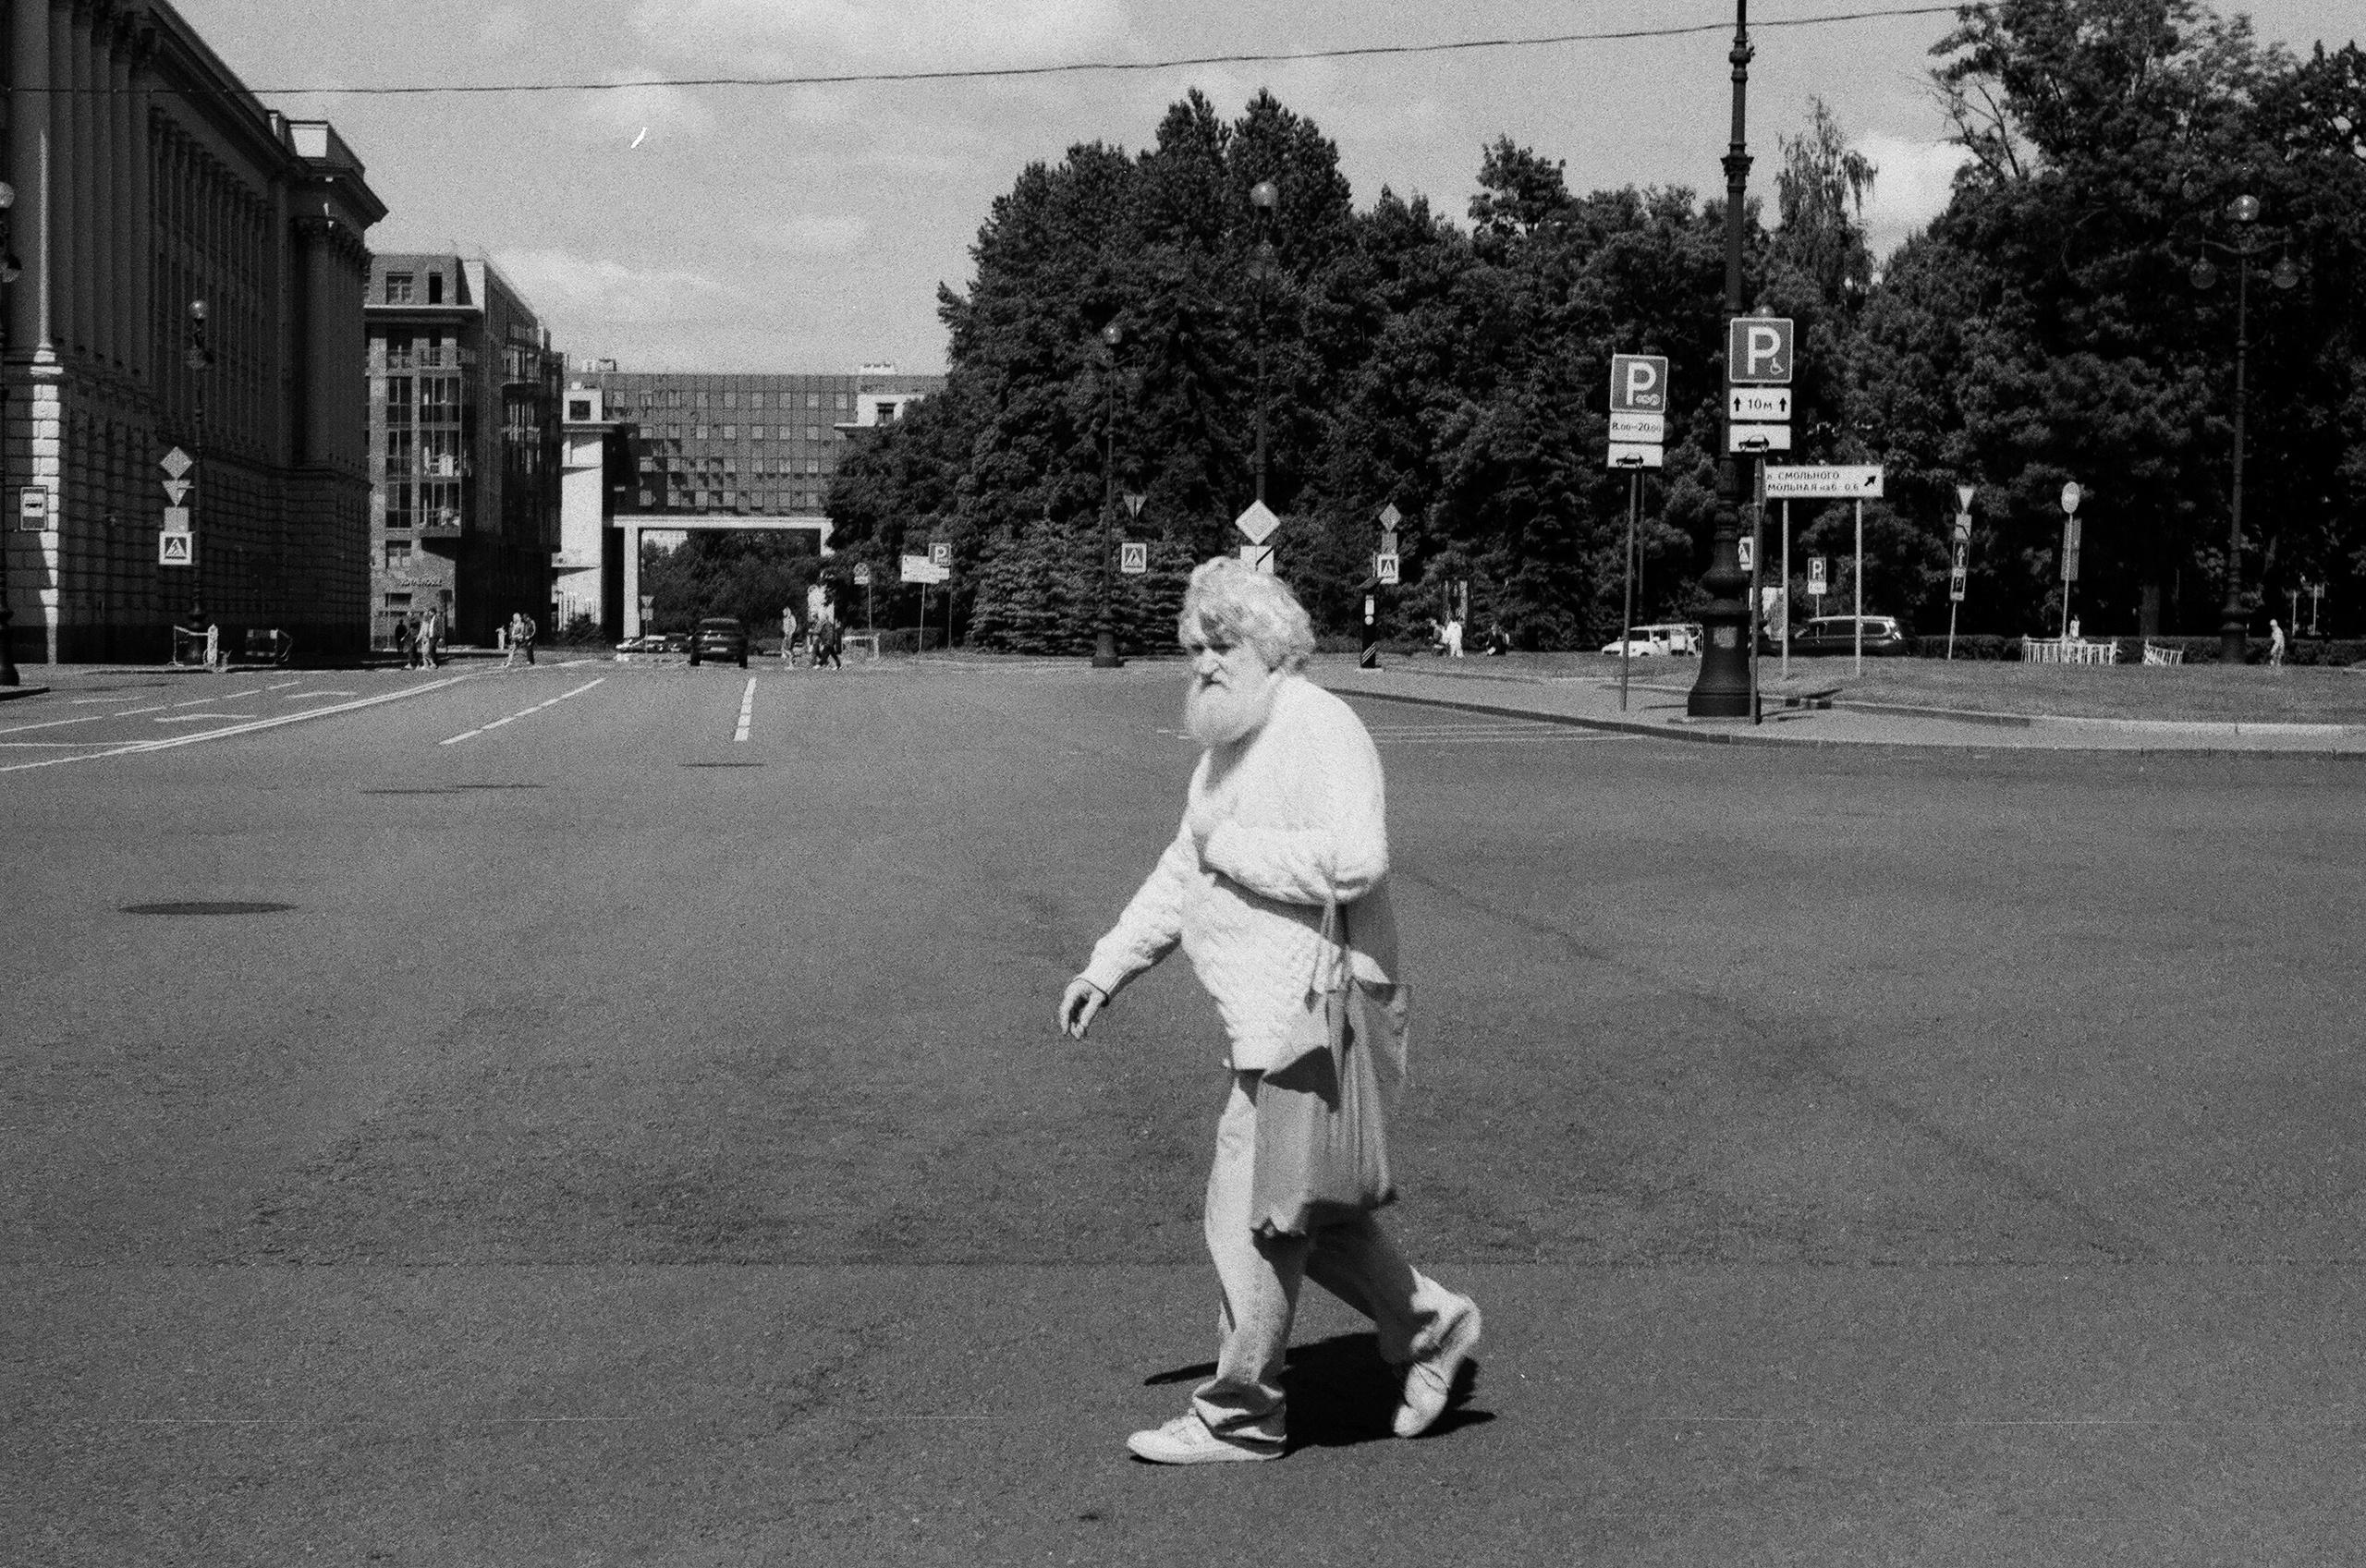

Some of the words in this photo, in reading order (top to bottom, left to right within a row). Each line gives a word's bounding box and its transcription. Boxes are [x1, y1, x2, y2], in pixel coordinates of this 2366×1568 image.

[1748, 326, 1781, 375] P
[1627, 361, 1656, 406] P
[1767, 483, 1817, 492] МОЛЬНАЯ
[1778, 471, 1840, 480] СМОЛЬНОГО
